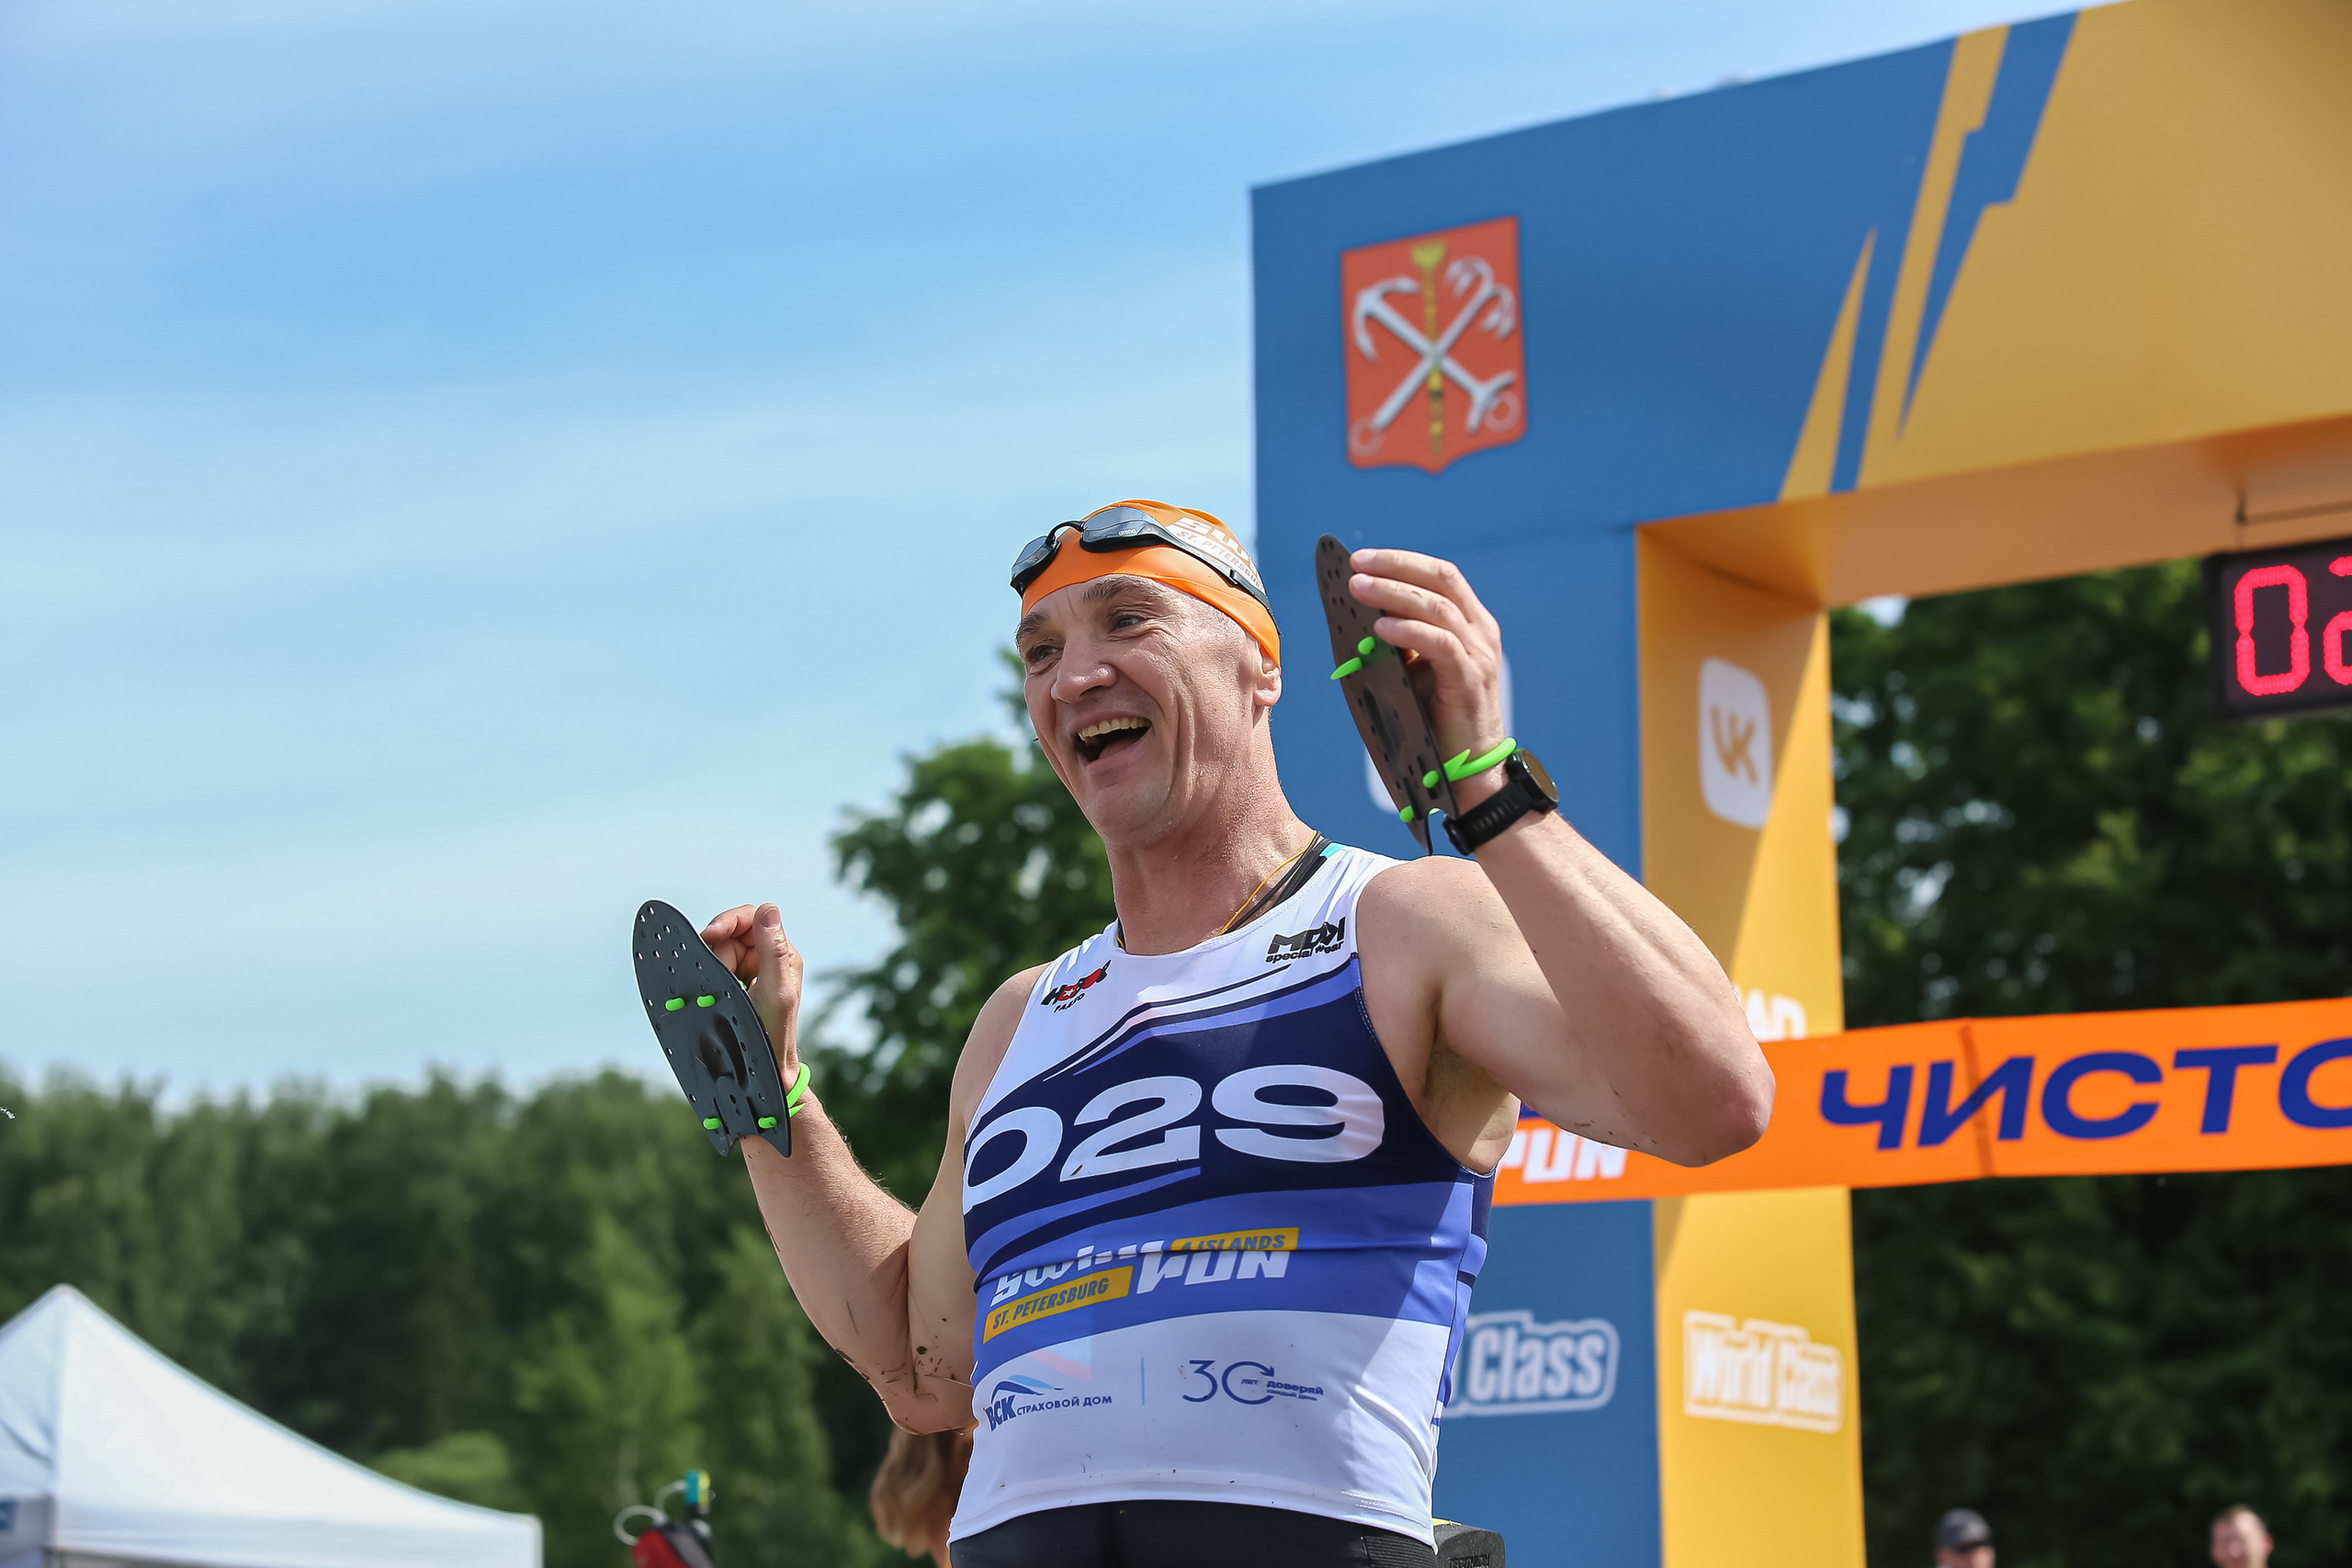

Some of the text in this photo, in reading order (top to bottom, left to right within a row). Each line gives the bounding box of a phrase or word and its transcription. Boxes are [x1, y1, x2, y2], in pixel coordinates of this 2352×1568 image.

[1202, 540, 1264, 590] PETERSBUR
[1265, 941, 1344, 964] special wear
[963, 1065, 1385, 1215] 029
[993, 1278, 1109, 1329] ST. PETERSBURG
[1470, 1325, 1606, 1404] Class
[1017, 1395, 1112, 1416] СТРАХОВОЙ ДОМ
[1266, 1380, 1324, 1395] доверяй
[985, 1394, 1017, 1432] ВСК
